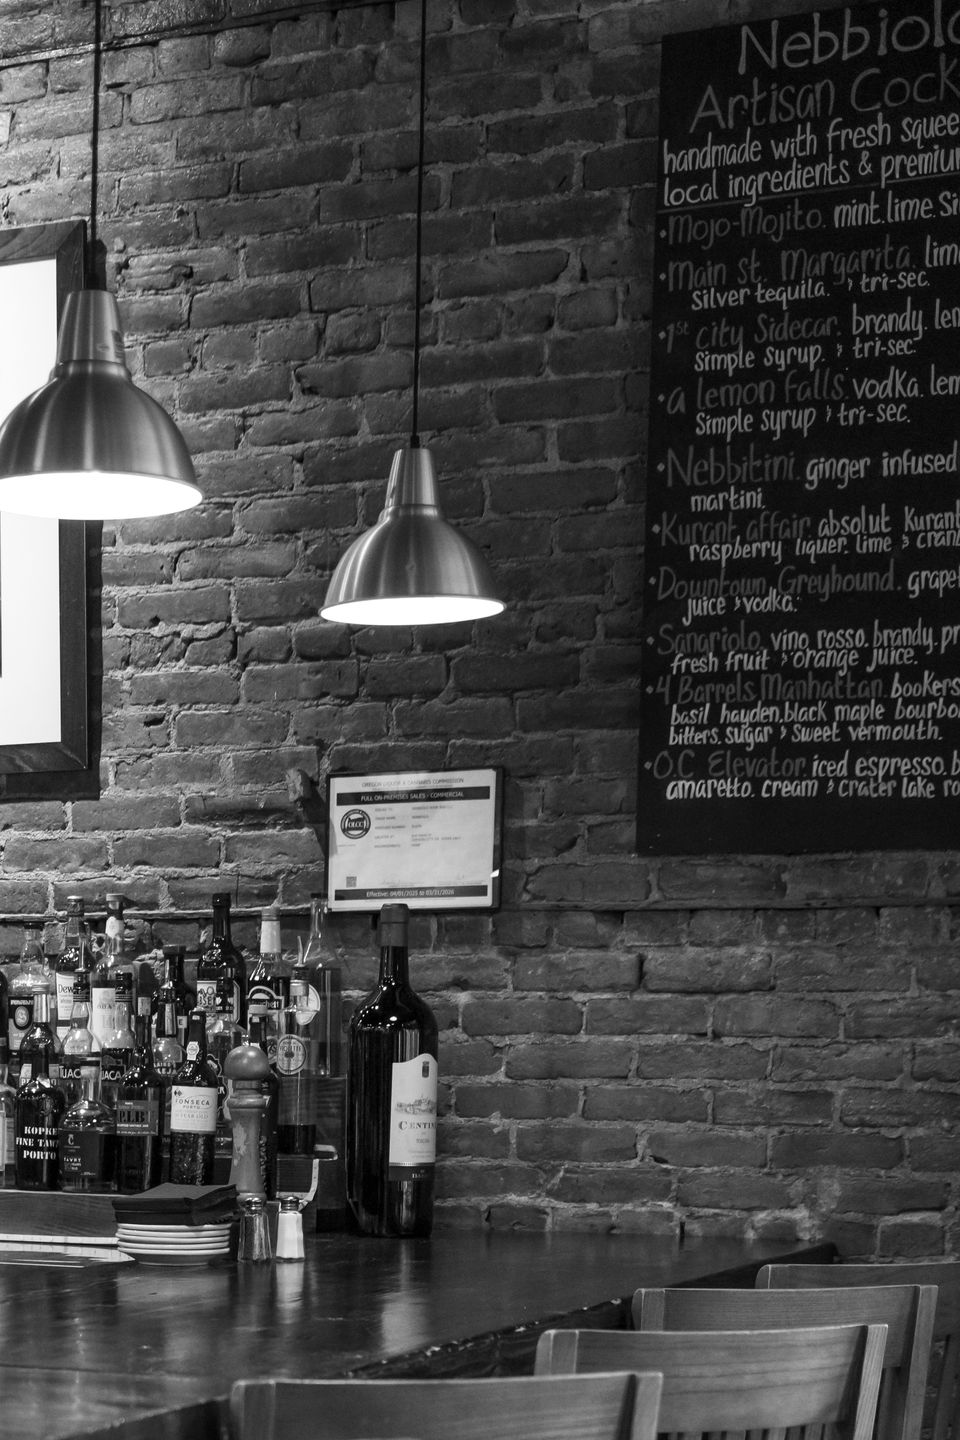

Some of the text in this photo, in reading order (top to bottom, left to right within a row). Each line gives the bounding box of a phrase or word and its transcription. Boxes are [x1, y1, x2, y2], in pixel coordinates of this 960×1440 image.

[690, 77, 835, 133] Artisan
[663, 127, 762, 174] handmade
[771, 122, 818, 160] with
[827, 112, 891, 152] fresh
[663, 169, 718, 207] local
[728, 152, 850, 208] ingredients
[858, 150, 873, 176] &
[668, 260, 727, 292] Main
[925, 234, 960, 268] lim
[691, 287, 751, 312] silver
[756, 278, 831, 311] tequila.
[860, 270, 931, 293] tri-sec.
[852, 296, 928, 341] brandy.
[852, 337, 917, 360] tri-sec.
[760, 407, 817, 441] syrup
[838, 402, 911, 427] tri-sec.
[805, 455, 870, 491] ginger
[882, 440, 958, 477] infused
[818, 503, 892, 536] absolut
[689, 535, 782, 569] raspberry
[856, 534, 892, 554] lime
[657, 566, 767, 600] Downtown
[907, 564, 960, 599] grape
[682, 596, 726, 626] juice
[770, 628, 809, 652] vino
[670, 651, 719, 675] fresh
[725, 649, 771, 673] fruit
[792, 648, 860, 677] orange
[670, 702, 709, 726] basil
[834, 698, 885, 731] maple
[894, 697, 960, 721] bourbo
[725, 725, 773, 751] sugar
[761, 778, 818, 798] cream
[839, 777, 897, 798] crater
[175, 1098, 210, 1106] FONSECA
[24, 1126, 58, 1136] KOPKE
[23, 1150, 57, 1160] PORTO
